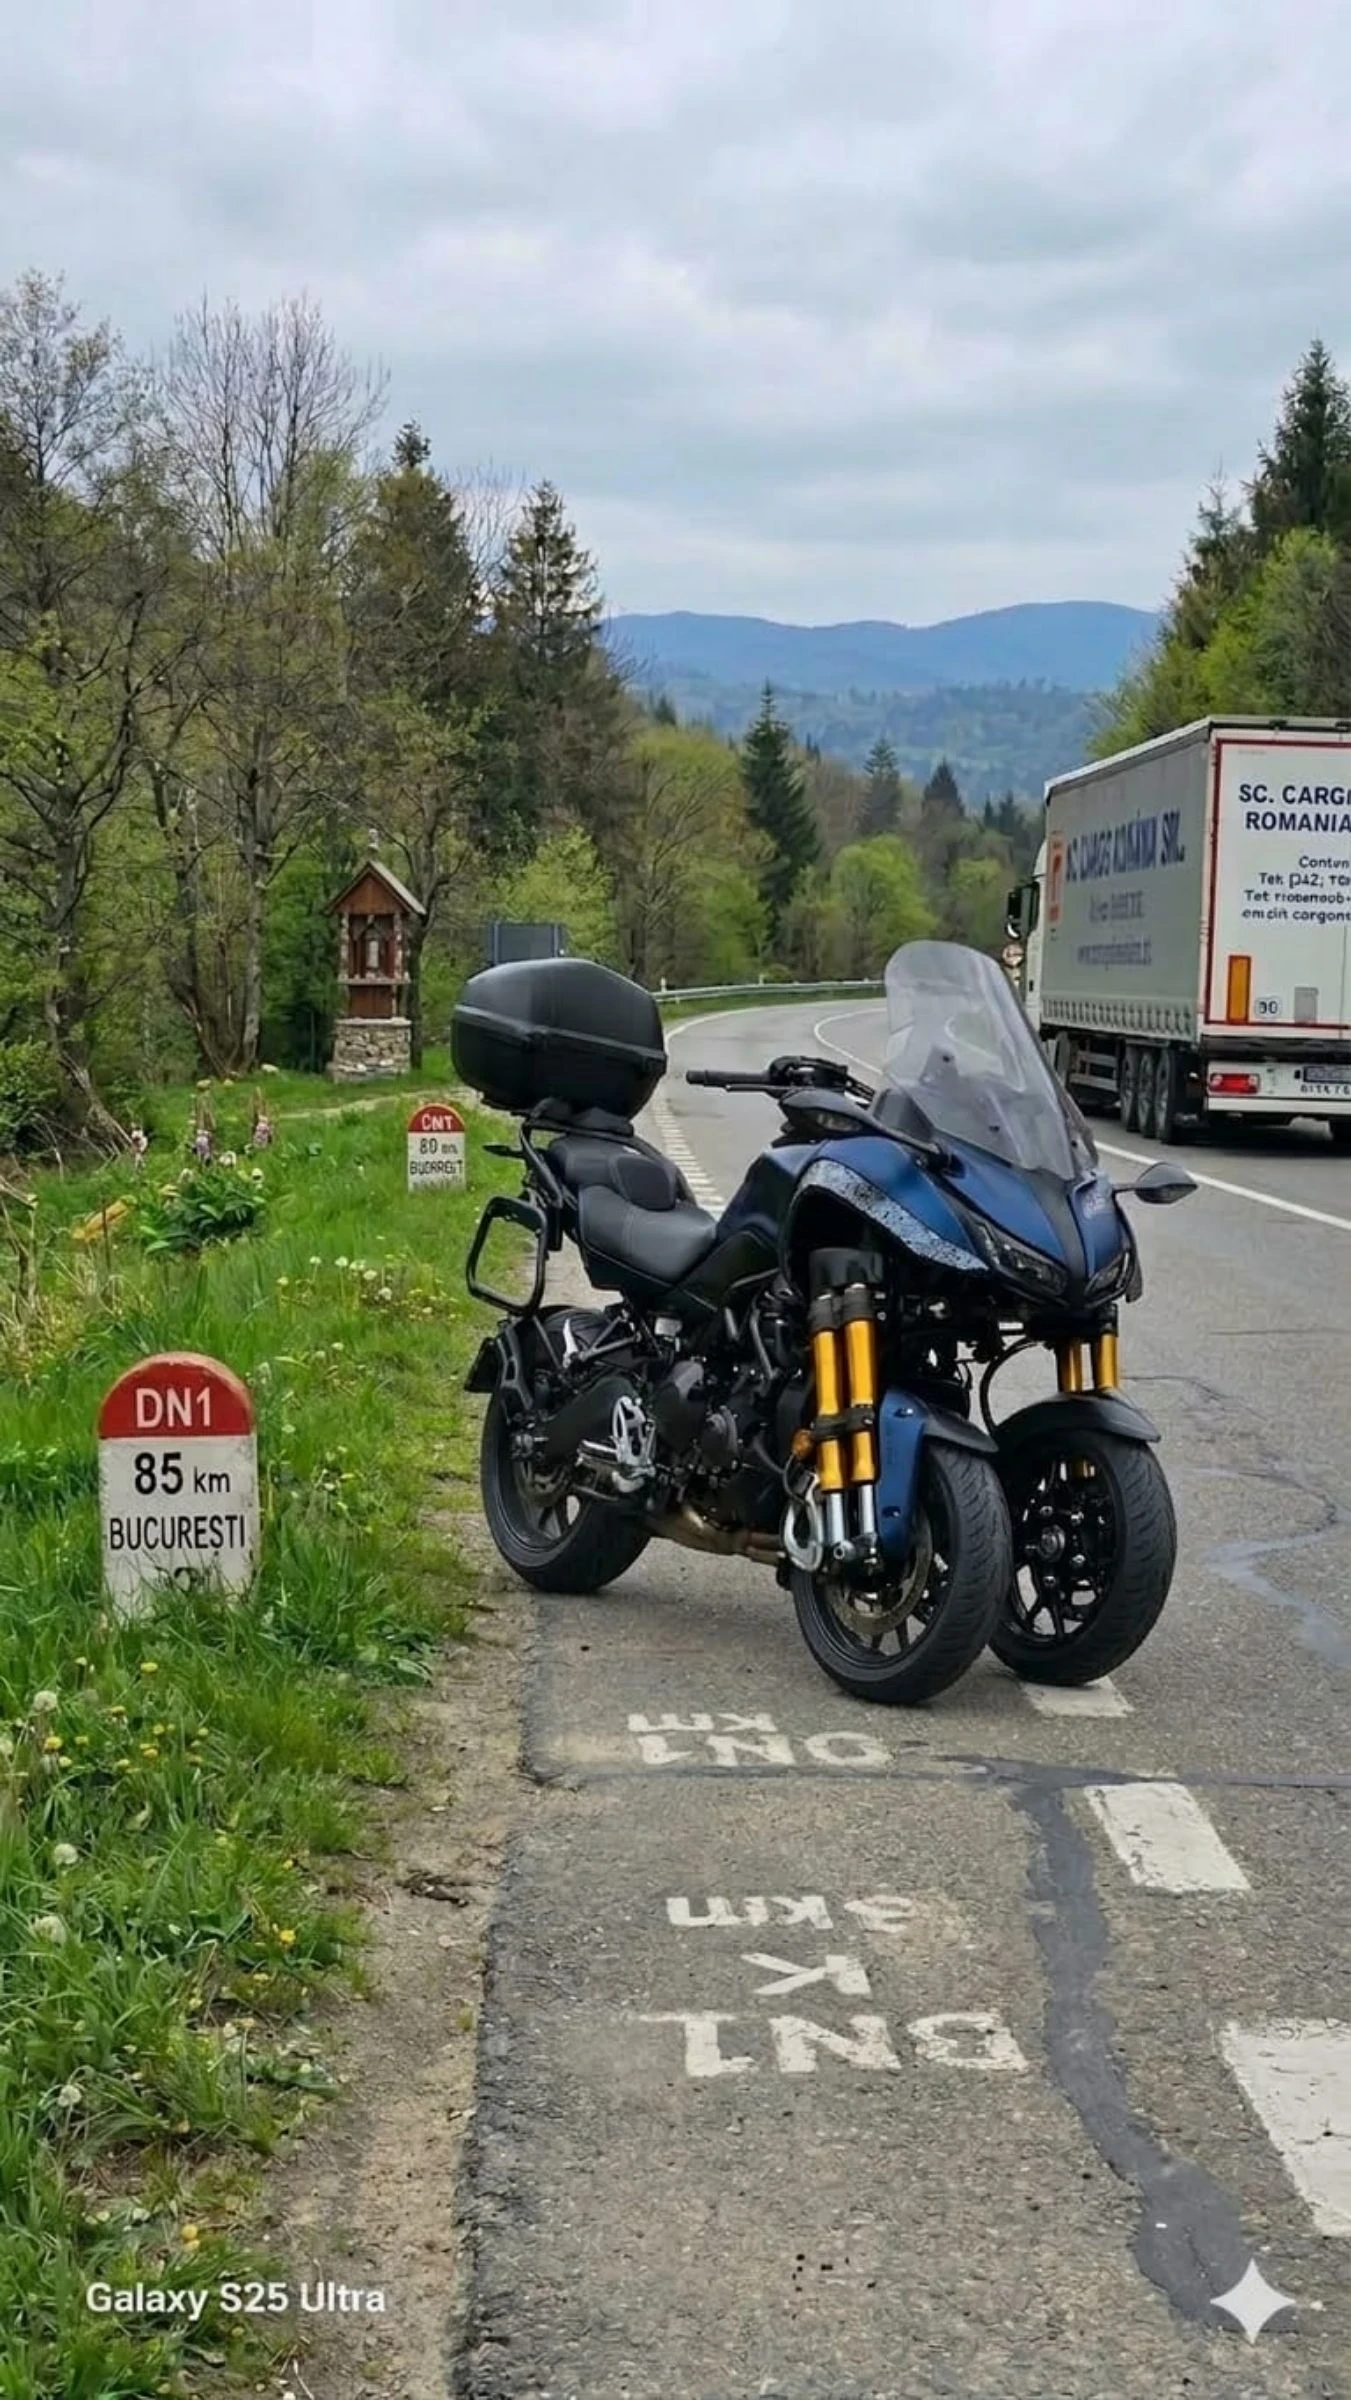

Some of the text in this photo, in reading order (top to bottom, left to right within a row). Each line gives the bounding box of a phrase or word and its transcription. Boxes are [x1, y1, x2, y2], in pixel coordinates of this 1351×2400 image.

[1282, 785, 1351, 805] CARG
[1246, 811, 1351, 833] ROMANIA
[135, 1387, 212, 1429] DN1
[134, 1452, 231, 1495] 85 km
